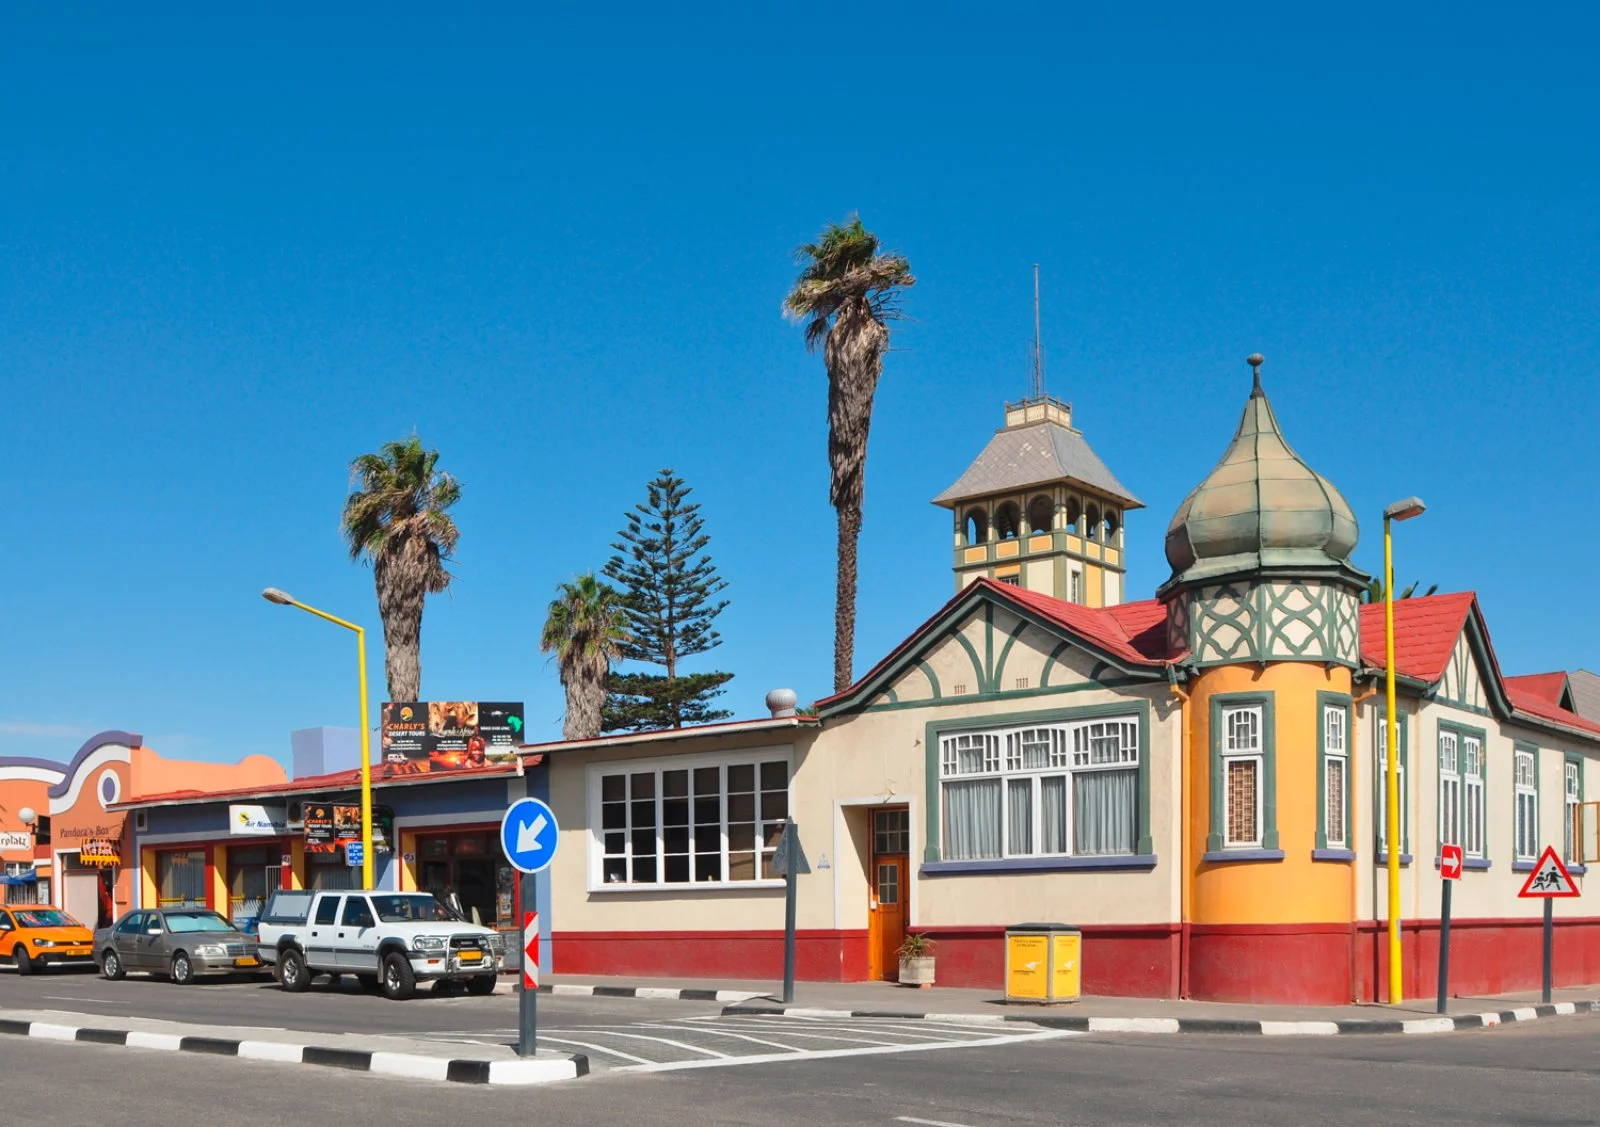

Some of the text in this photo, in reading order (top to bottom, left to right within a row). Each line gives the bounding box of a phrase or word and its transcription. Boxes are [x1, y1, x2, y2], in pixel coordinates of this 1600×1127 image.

[257, 820, 285, 828] Namibia
[60, 825, 109, 838] Pandora's Box
